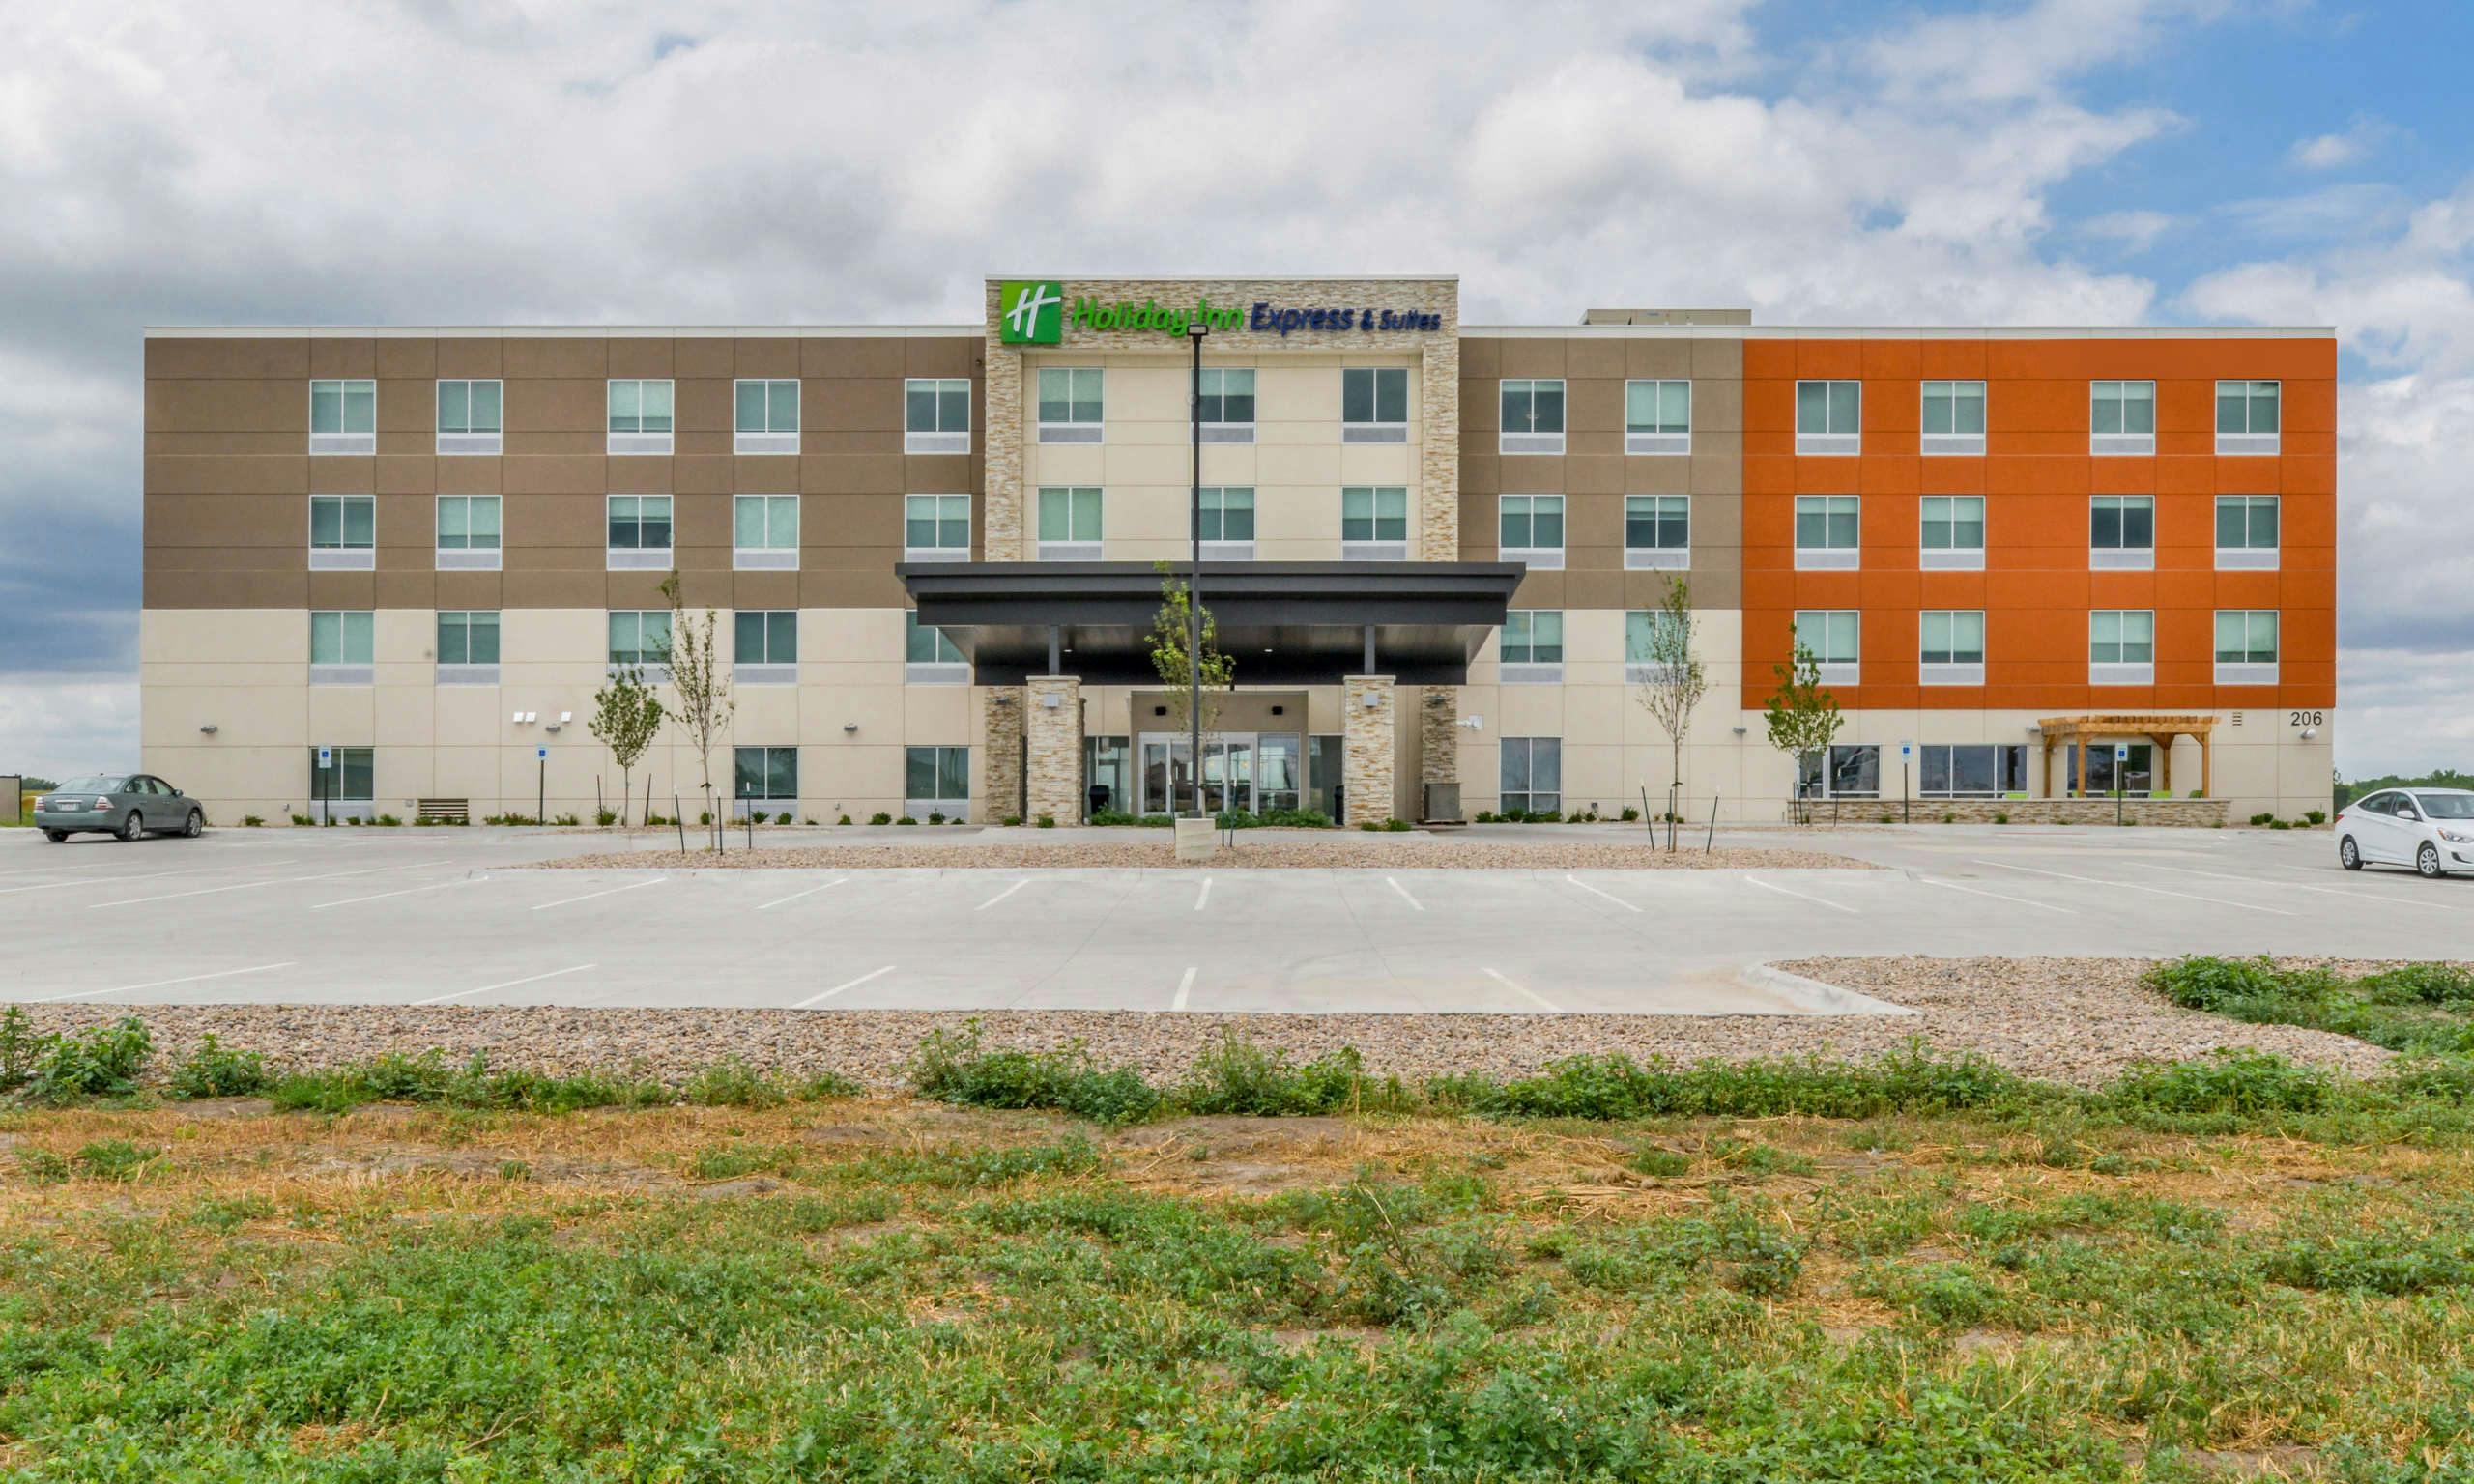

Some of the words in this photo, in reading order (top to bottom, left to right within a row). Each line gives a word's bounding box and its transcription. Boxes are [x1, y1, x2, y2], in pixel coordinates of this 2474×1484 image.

[1072, 296, 1192, 337] Holiday
[1196, 298, 1244, 330] Inn
[1250, 302, 1355, 337] Express
[1360, 309, 1374, 330] &
[1378, 309, 1441, 330] Suites
[2290, 711, 2322, 726] 206
